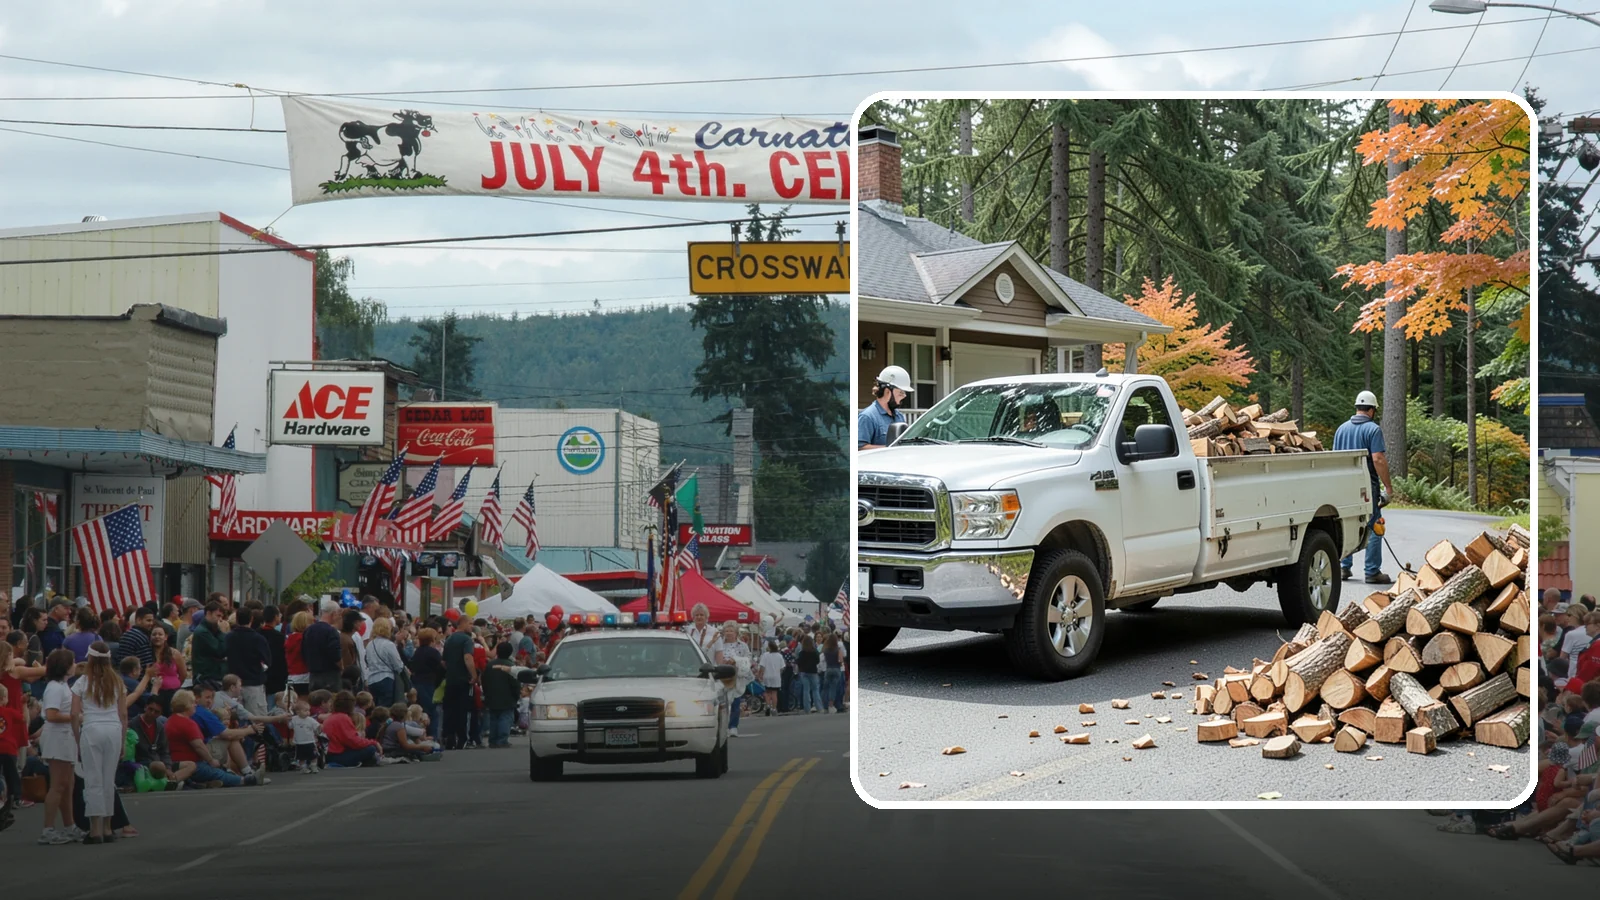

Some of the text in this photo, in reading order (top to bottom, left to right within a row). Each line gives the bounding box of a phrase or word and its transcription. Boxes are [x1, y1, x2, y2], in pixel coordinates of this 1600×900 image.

[481, 142, 604, 193] JULY
[632, 149, 746, 197] 4th.
[697, 254, 850, 280] CROSSWA
[282, 380, 374, 420] ACE
[406, 409, 452, 422] CEDAR
[283, 421, 371, 437] Hardware
[416, 428, 477, 447] Coca-Cola
[353, 467, 386, 480] Simpl
[83, 484, 155, 495] St. Vincent de Paul
[688, 526, 741, 535] CRNATION
[699, 535, 730, 543] GLASS
